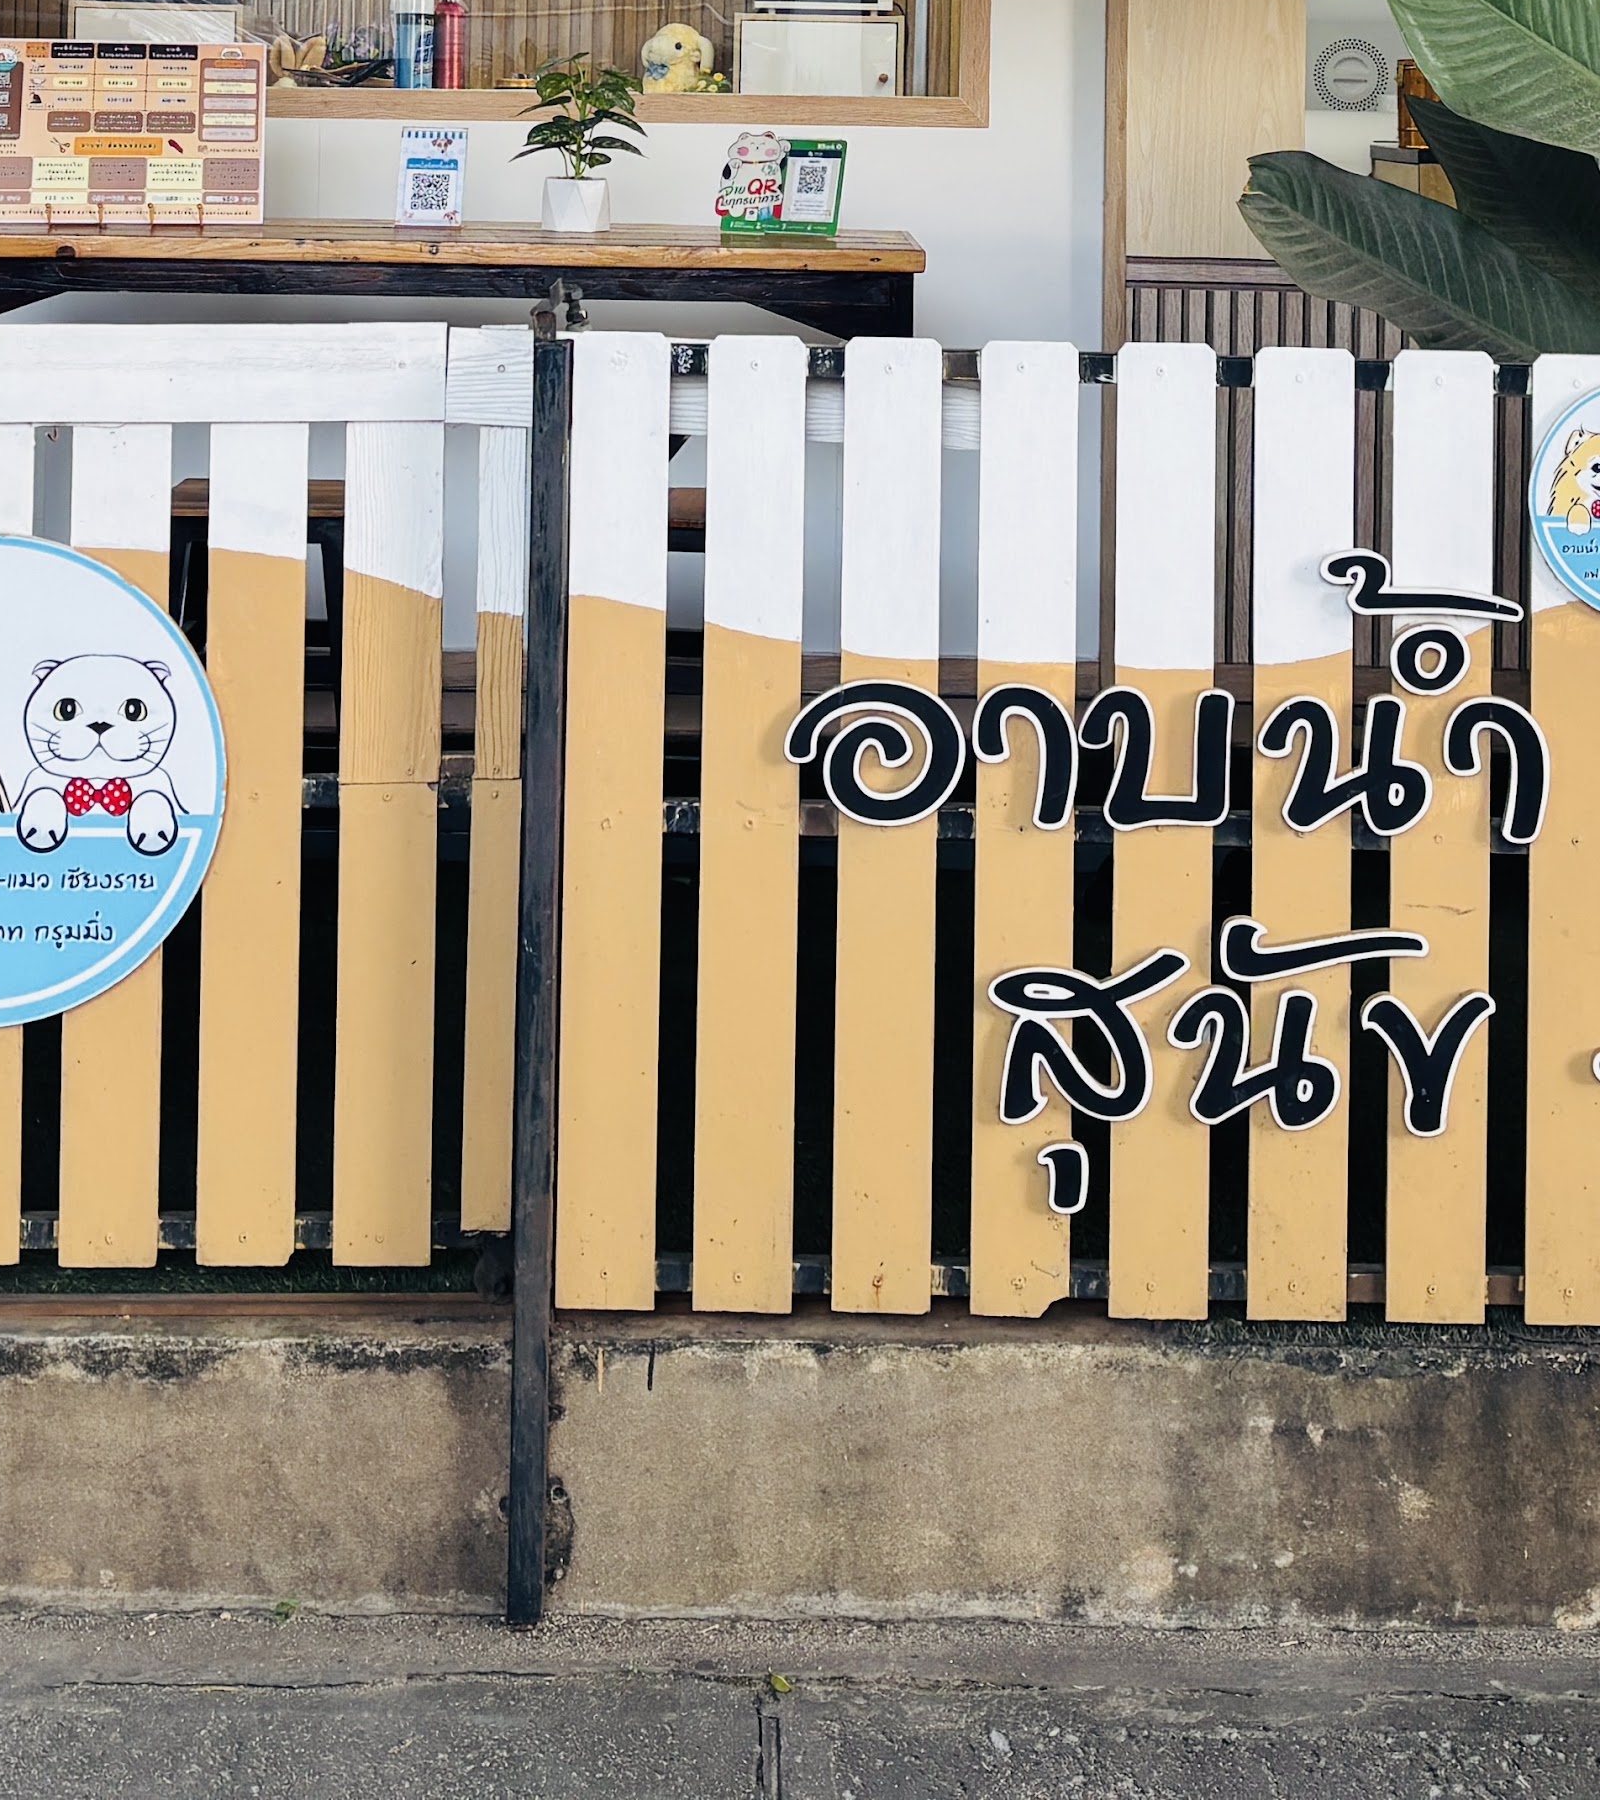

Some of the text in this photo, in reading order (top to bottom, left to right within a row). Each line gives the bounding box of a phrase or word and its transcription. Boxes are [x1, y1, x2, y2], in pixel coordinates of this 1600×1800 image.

[747, 178, 778, 196] QR
[1562, 538, 1599, 554] อาบน้ำ
[784, 549, 1551, 843] อาบน้ำ
[61, 867, 154, 889] เชียงราย
[35, 910, 113, 949] กรูมมิ่ง
[988, 916, 1496, 1214] สุนัข
